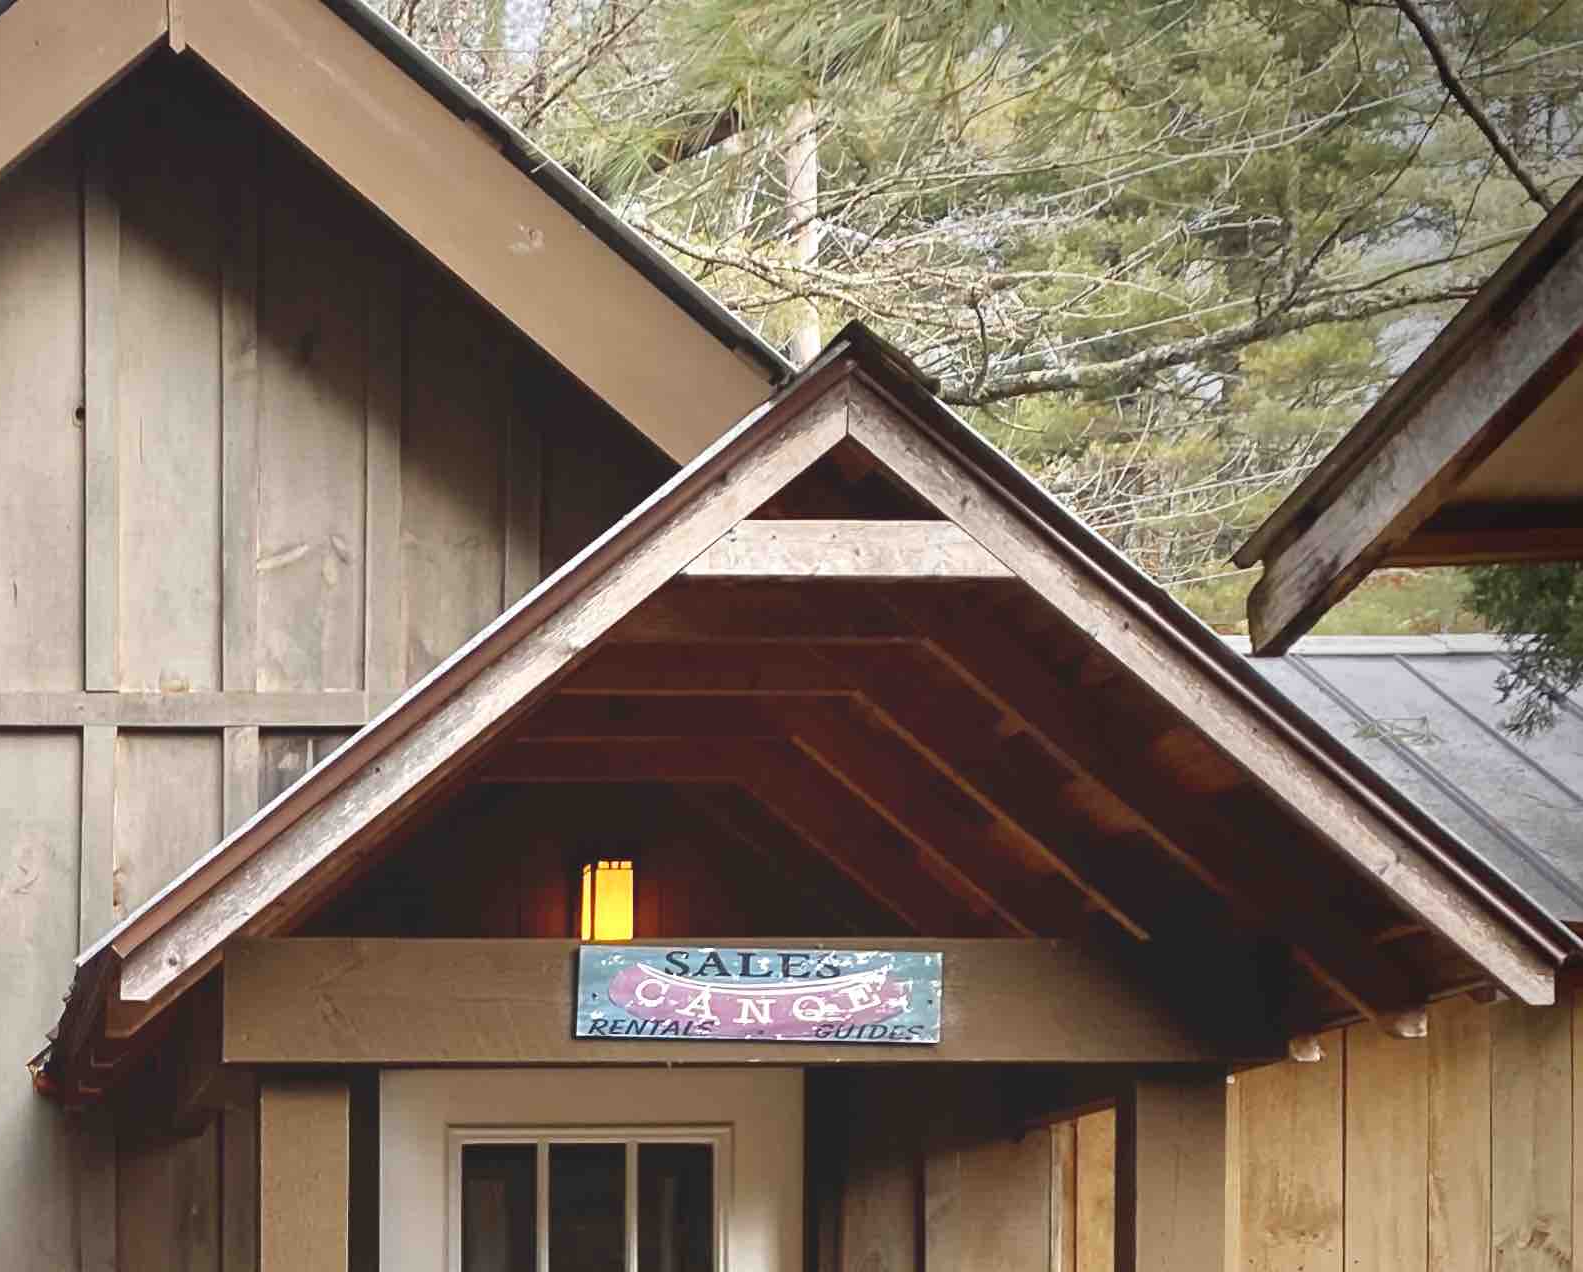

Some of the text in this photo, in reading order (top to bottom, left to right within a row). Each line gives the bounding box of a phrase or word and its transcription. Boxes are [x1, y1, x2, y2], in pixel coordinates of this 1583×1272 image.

[664, 950, 841, 978] SALES
[634, 978, 881, 1025] CANOE
[588, 1018, 924, 1041] RENTALS GUIDES
